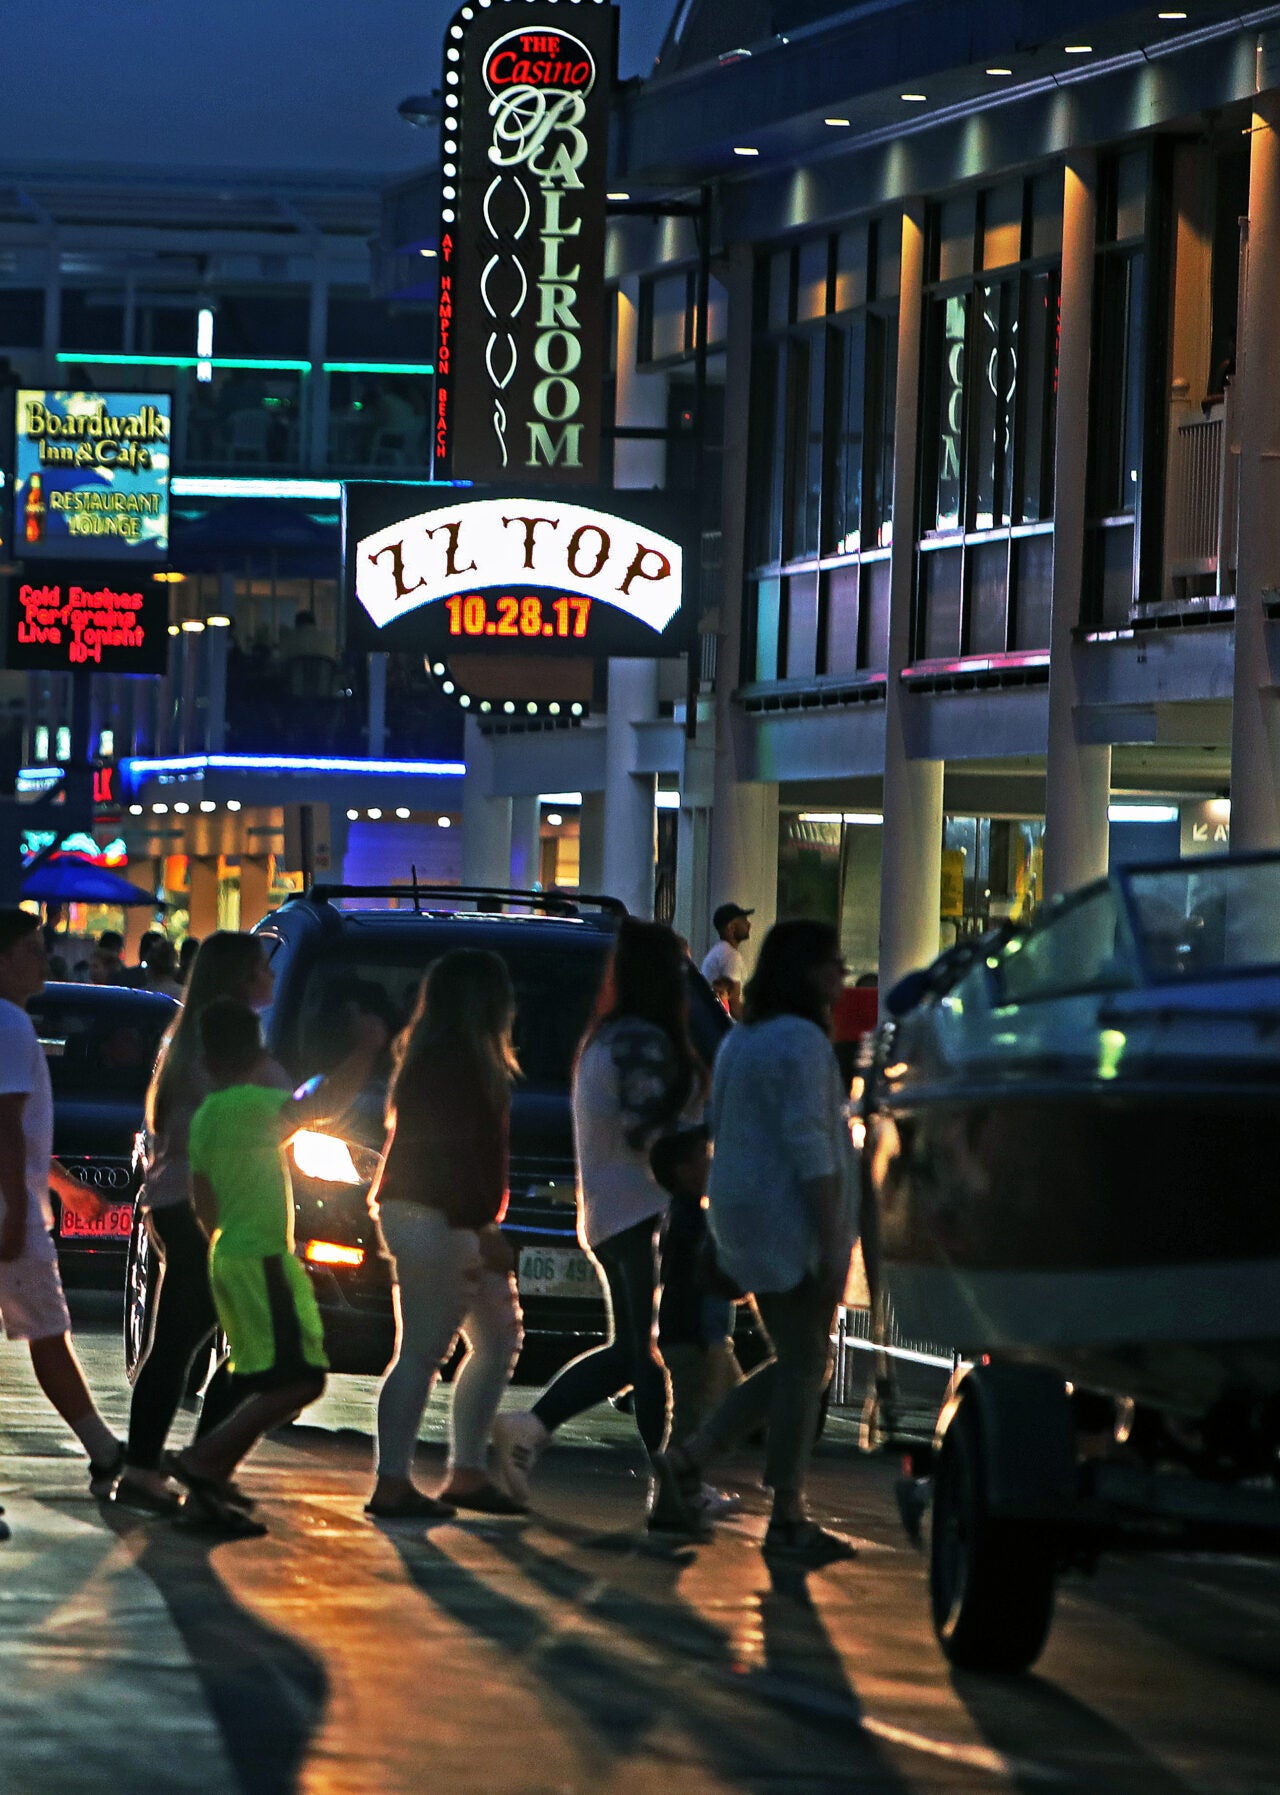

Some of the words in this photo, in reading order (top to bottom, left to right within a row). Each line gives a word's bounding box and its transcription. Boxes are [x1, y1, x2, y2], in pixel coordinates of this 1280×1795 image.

[520, 36, 561, 53] THE
[489, 51, 590, 85] Casino
[441, 233, 453, 262] AT
[488, 85, 589, 468] BALLROOM
[438, 276, 452, 375] HAMPTON
[26, 401, 167, 443] Boardwalk
[436, 388, 448, 458] BEACH
[50, 491, 161, 513] RESTAURANT
[69, 515, 140, 537] LOUNGE
[368, 520, 478, 600] ZZ
[502, 516, 671, 595] TOP
[19, 585, 60, 607] Cold
[18, 621, 61, 644] Live
[445, 595, 592, 638] 10.28.17
